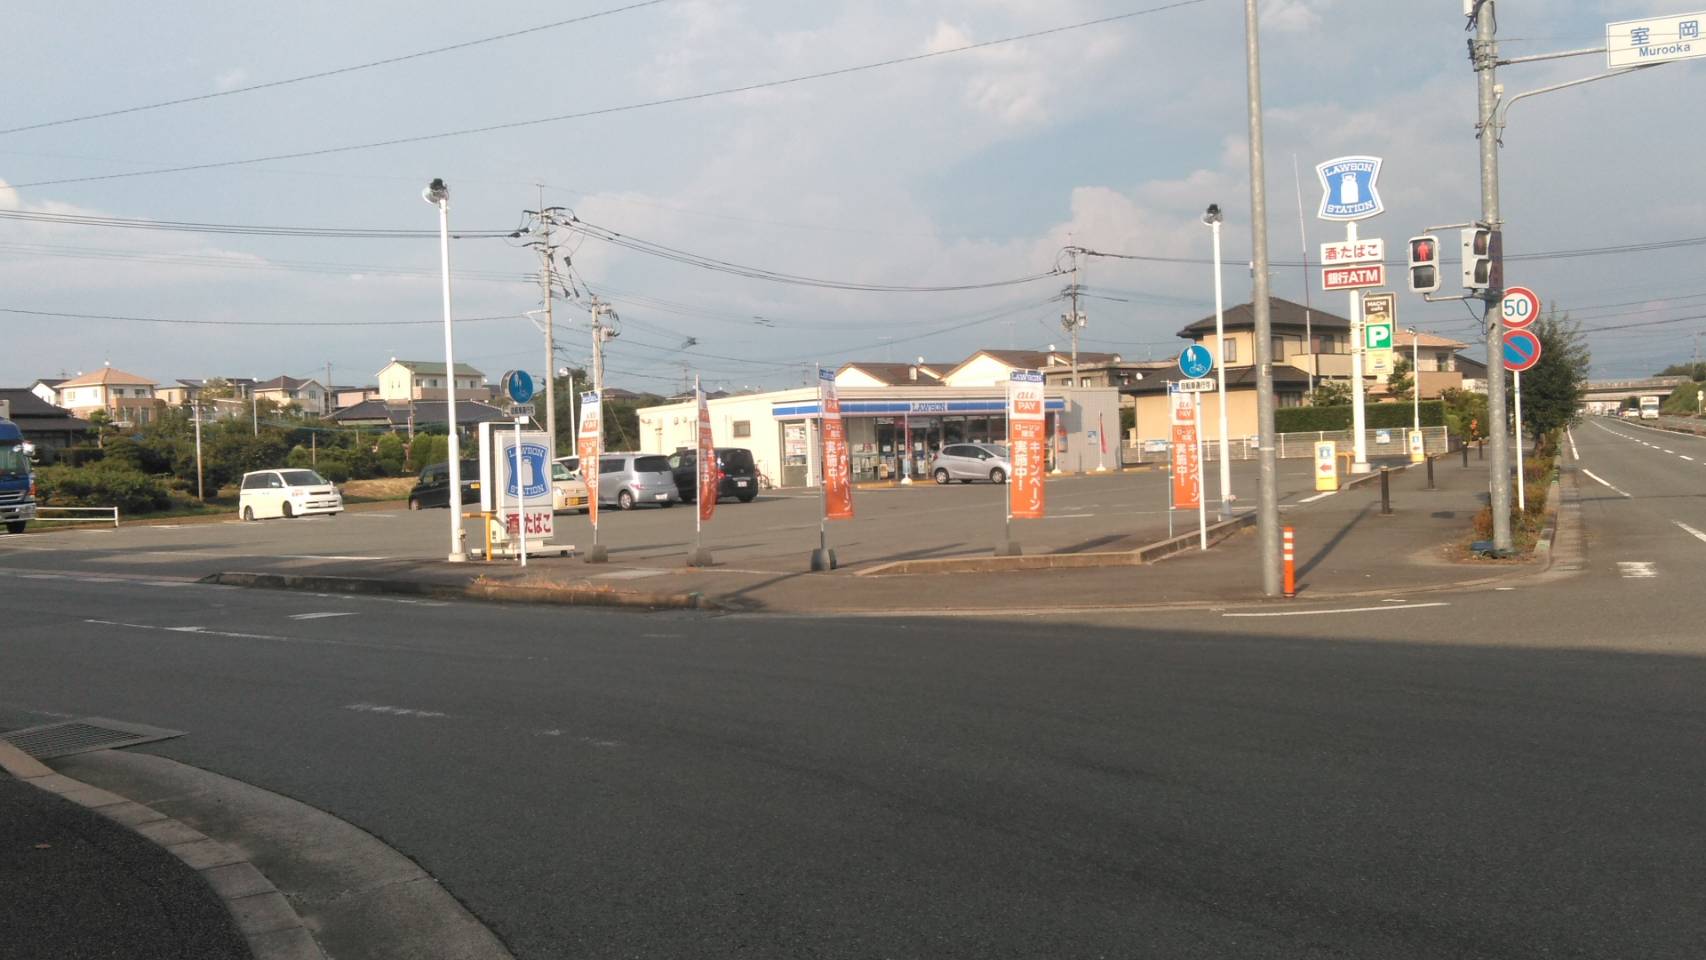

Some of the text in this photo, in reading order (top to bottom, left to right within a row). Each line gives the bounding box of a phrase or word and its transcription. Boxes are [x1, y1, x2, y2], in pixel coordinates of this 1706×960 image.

[1630, 20, 1698, 46] 室岡
[1639, 43, 1691, 57] Murooka
[1325, 162, 1373, 177] LAWSON
[1326, 199, 1375, 214] STATION
[1327, 269, 1378, 285] 銀行ATM
[1503, 298, 1529, 317] 50
[1368, 325, 1389, 348] P
[911, 402, 946, 412] LAWSON
[1017, 401, 1036, 410] PAY
[508, 445, 545, 458] LWSON
[1028, 440, 1041, 511] キャンペーン
